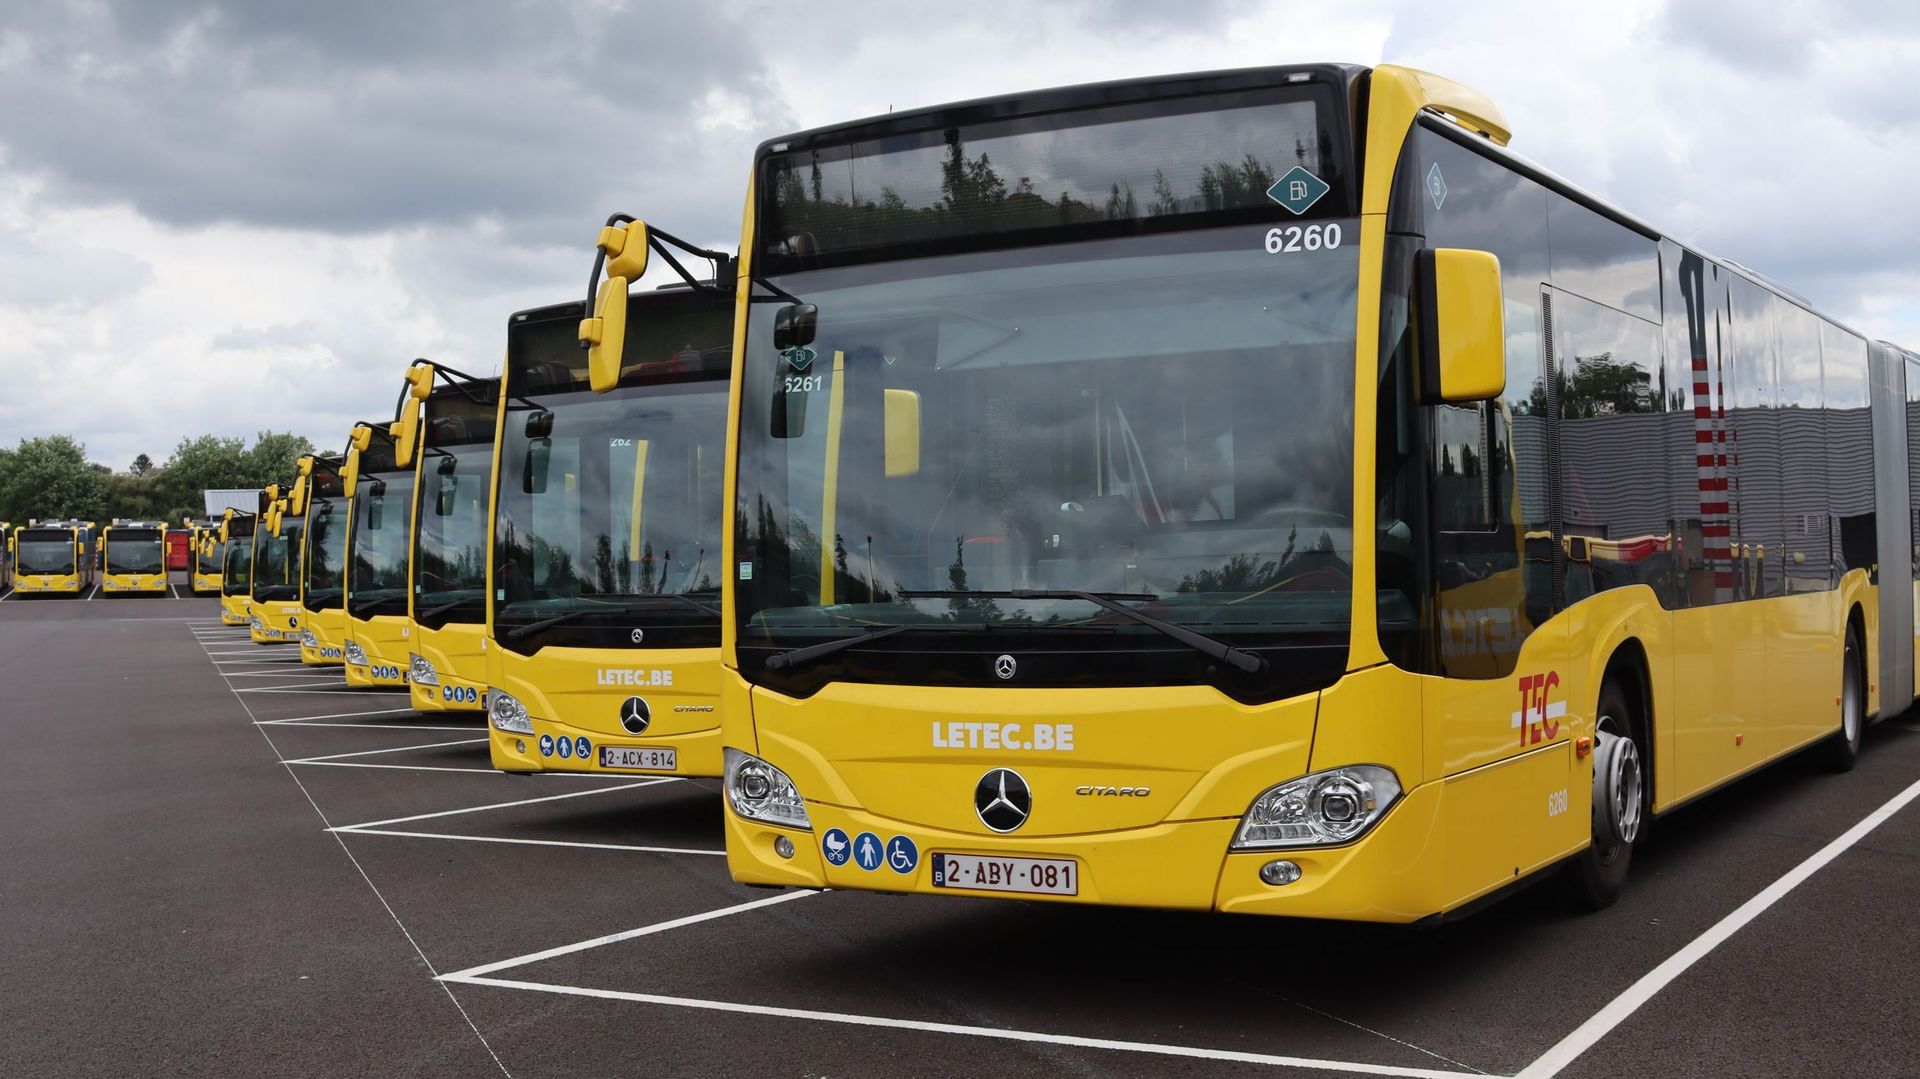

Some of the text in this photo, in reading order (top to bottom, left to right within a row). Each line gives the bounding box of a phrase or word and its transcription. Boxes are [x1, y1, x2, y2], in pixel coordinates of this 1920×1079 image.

[1265, 223, 1342, 254] 6260
[597, 669, 673, 686] LETEC.BE
[1518, 670, 1560, 748] TEC
[932, 722, 1074, 751] LETEC.BE
[1075, 785, 1151, 798] CITARO
[1548, 788, 1568, 817] 6260
[934, 859, 1071, 889] B 2-ABY-081
